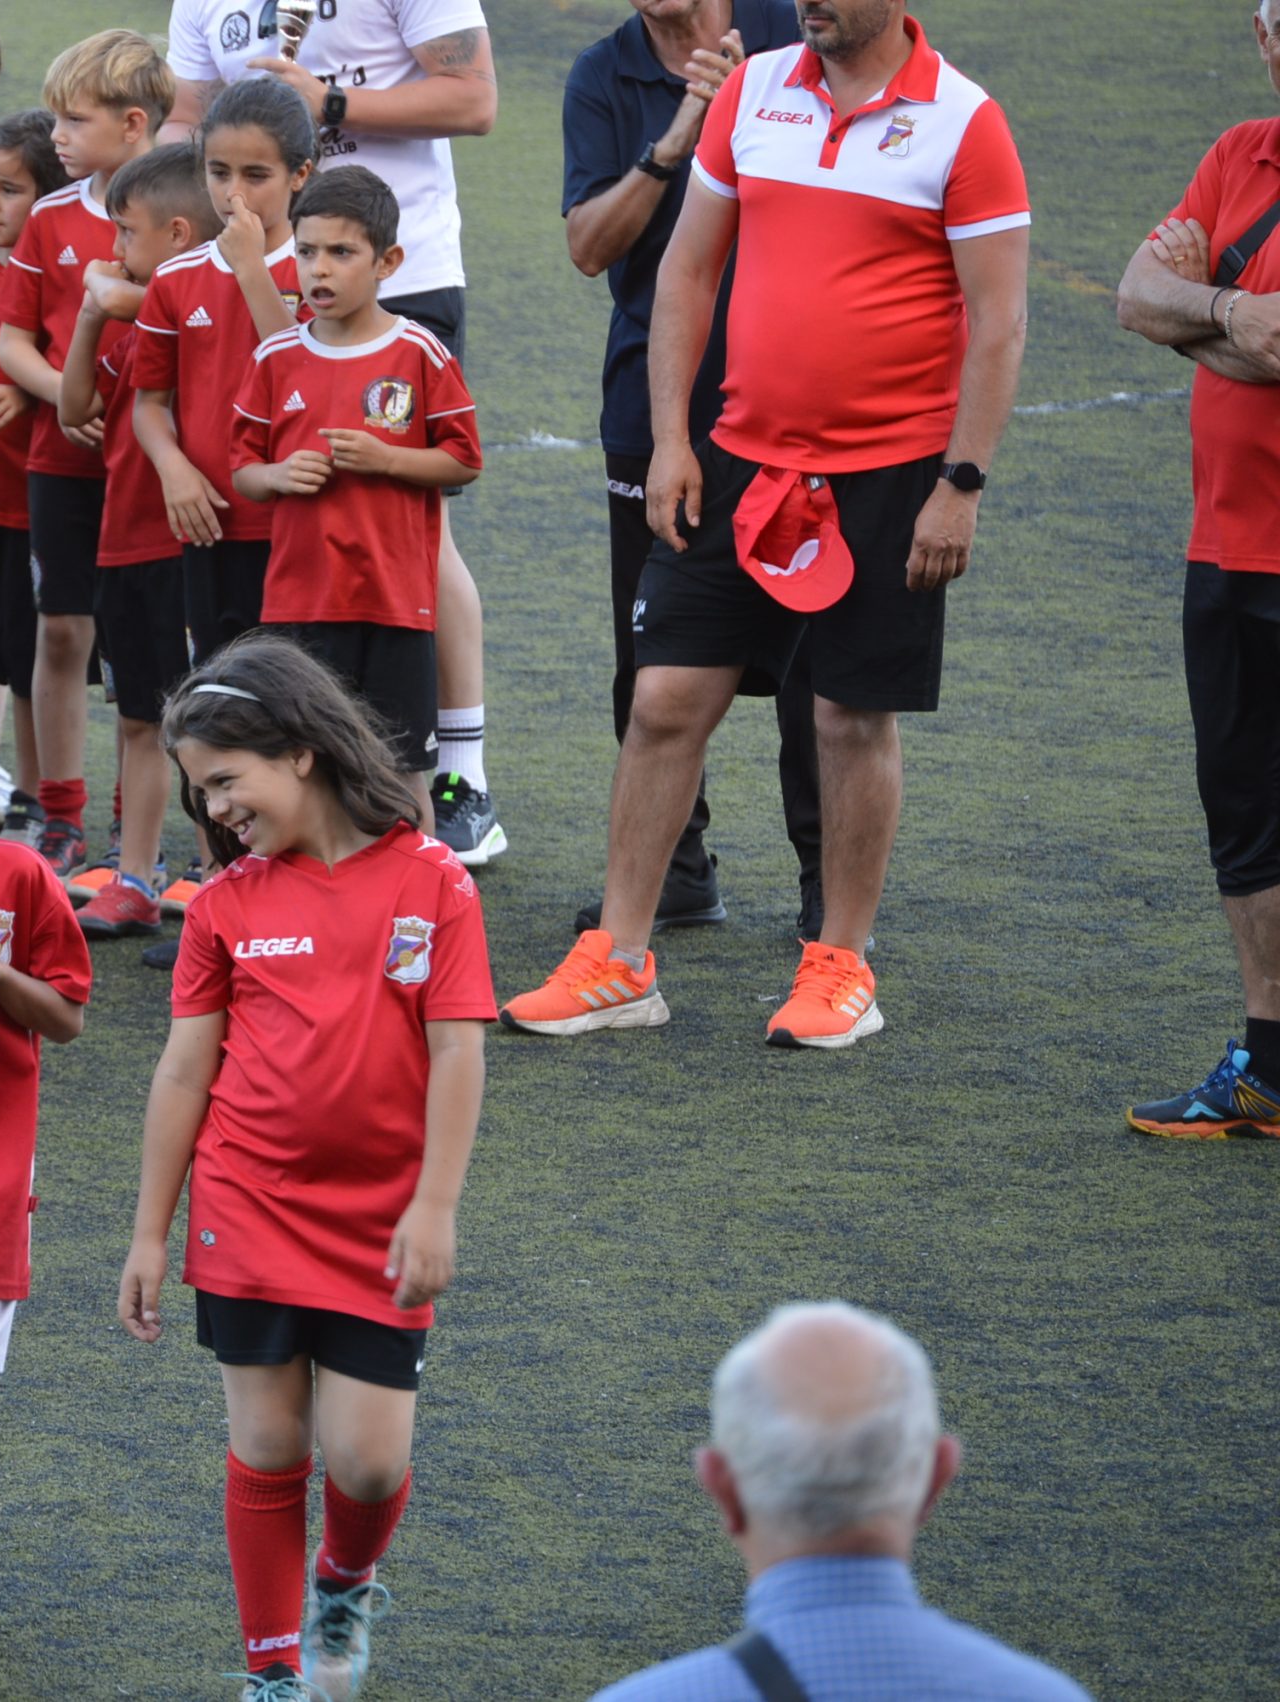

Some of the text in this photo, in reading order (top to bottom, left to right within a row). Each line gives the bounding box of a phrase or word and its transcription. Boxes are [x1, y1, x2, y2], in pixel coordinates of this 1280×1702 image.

[755, 108, 814, 125] LEGEA
[323, 141, 357, 157] CLUB
[234, 937, 315, 958] LEGEA
